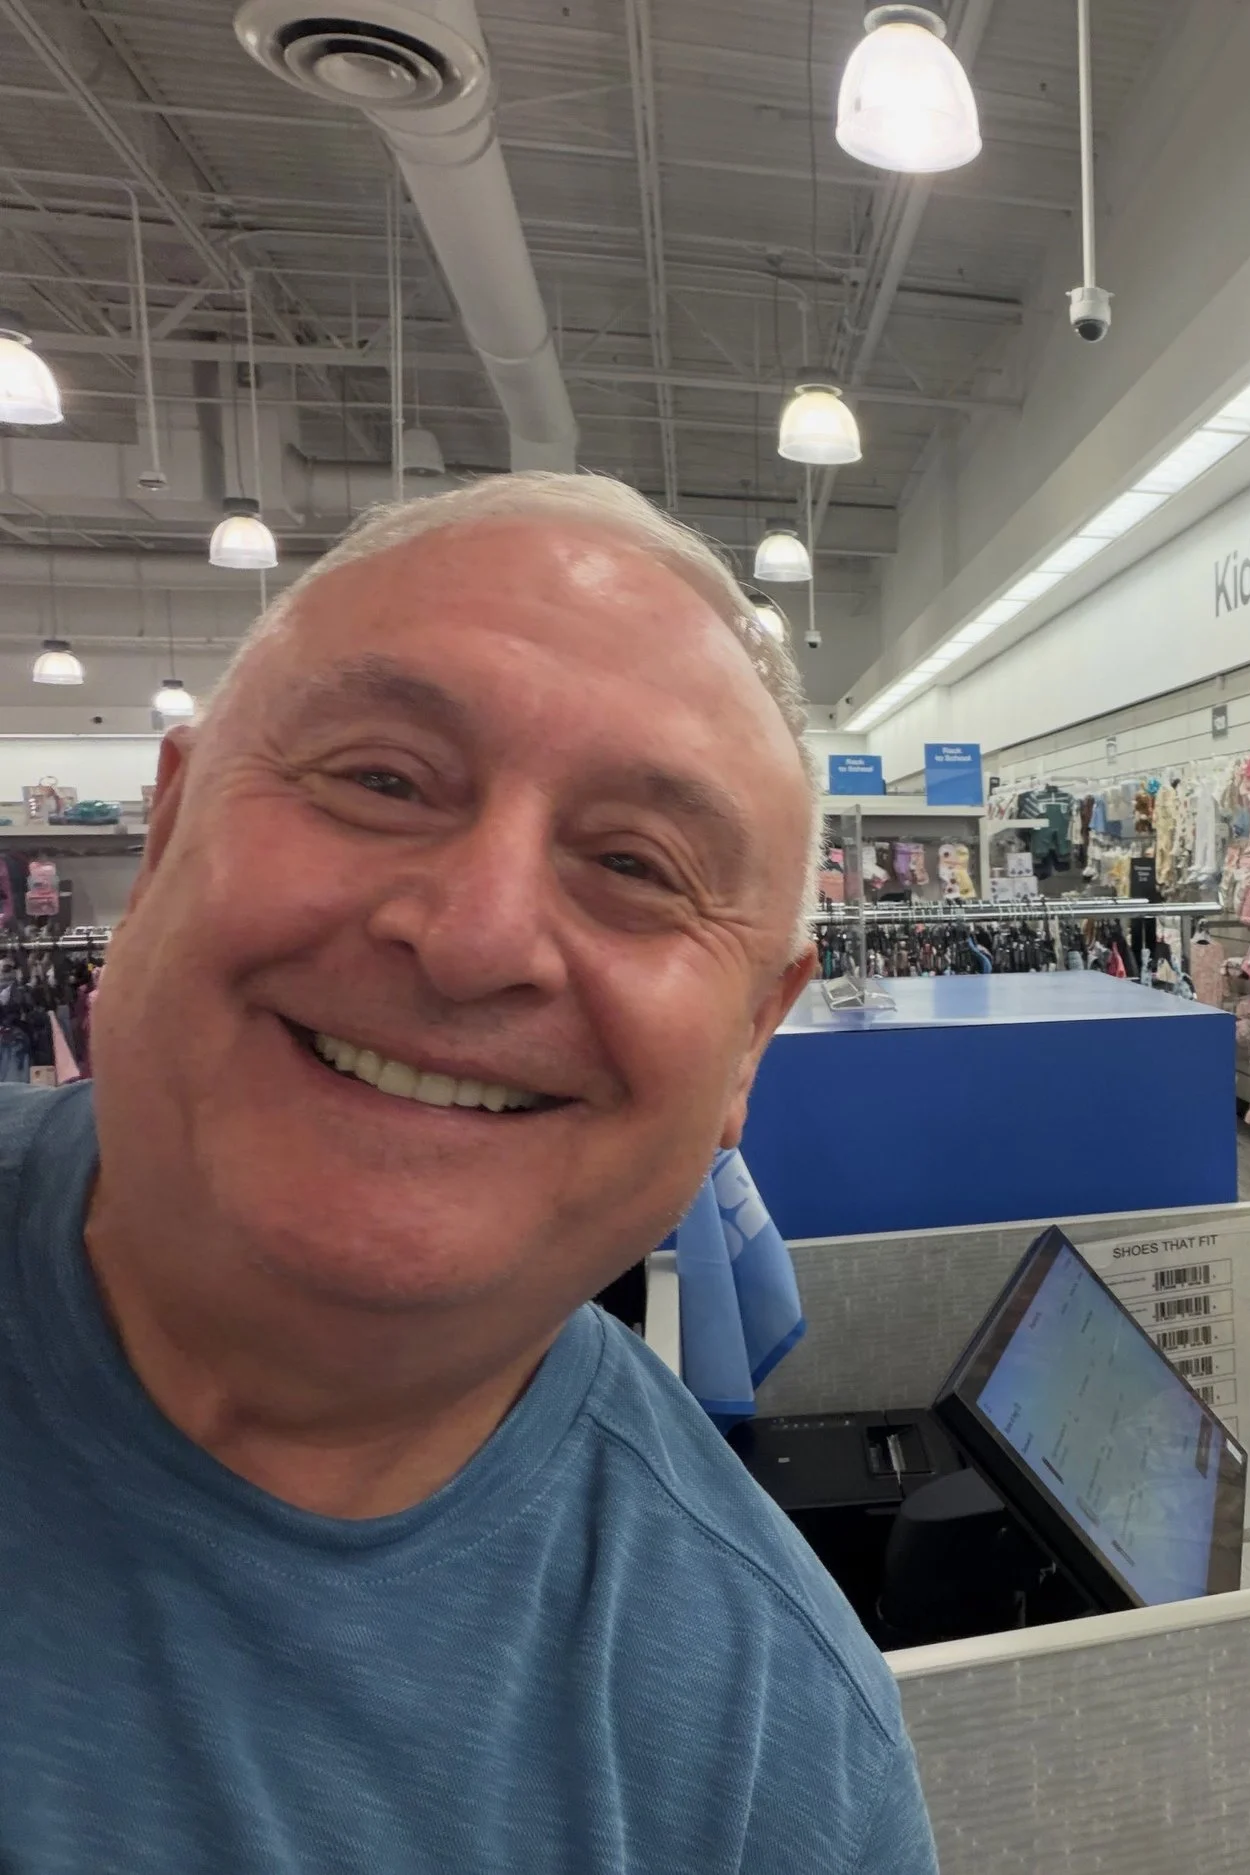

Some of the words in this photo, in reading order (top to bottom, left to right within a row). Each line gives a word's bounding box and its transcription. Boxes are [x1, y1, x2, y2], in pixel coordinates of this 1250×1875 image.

[1113, 1243, 1158, 1259] SHOES
[1162, 1237, 1195, 1252] THAT
[1199, 1234, 1218, 1248] FIT
